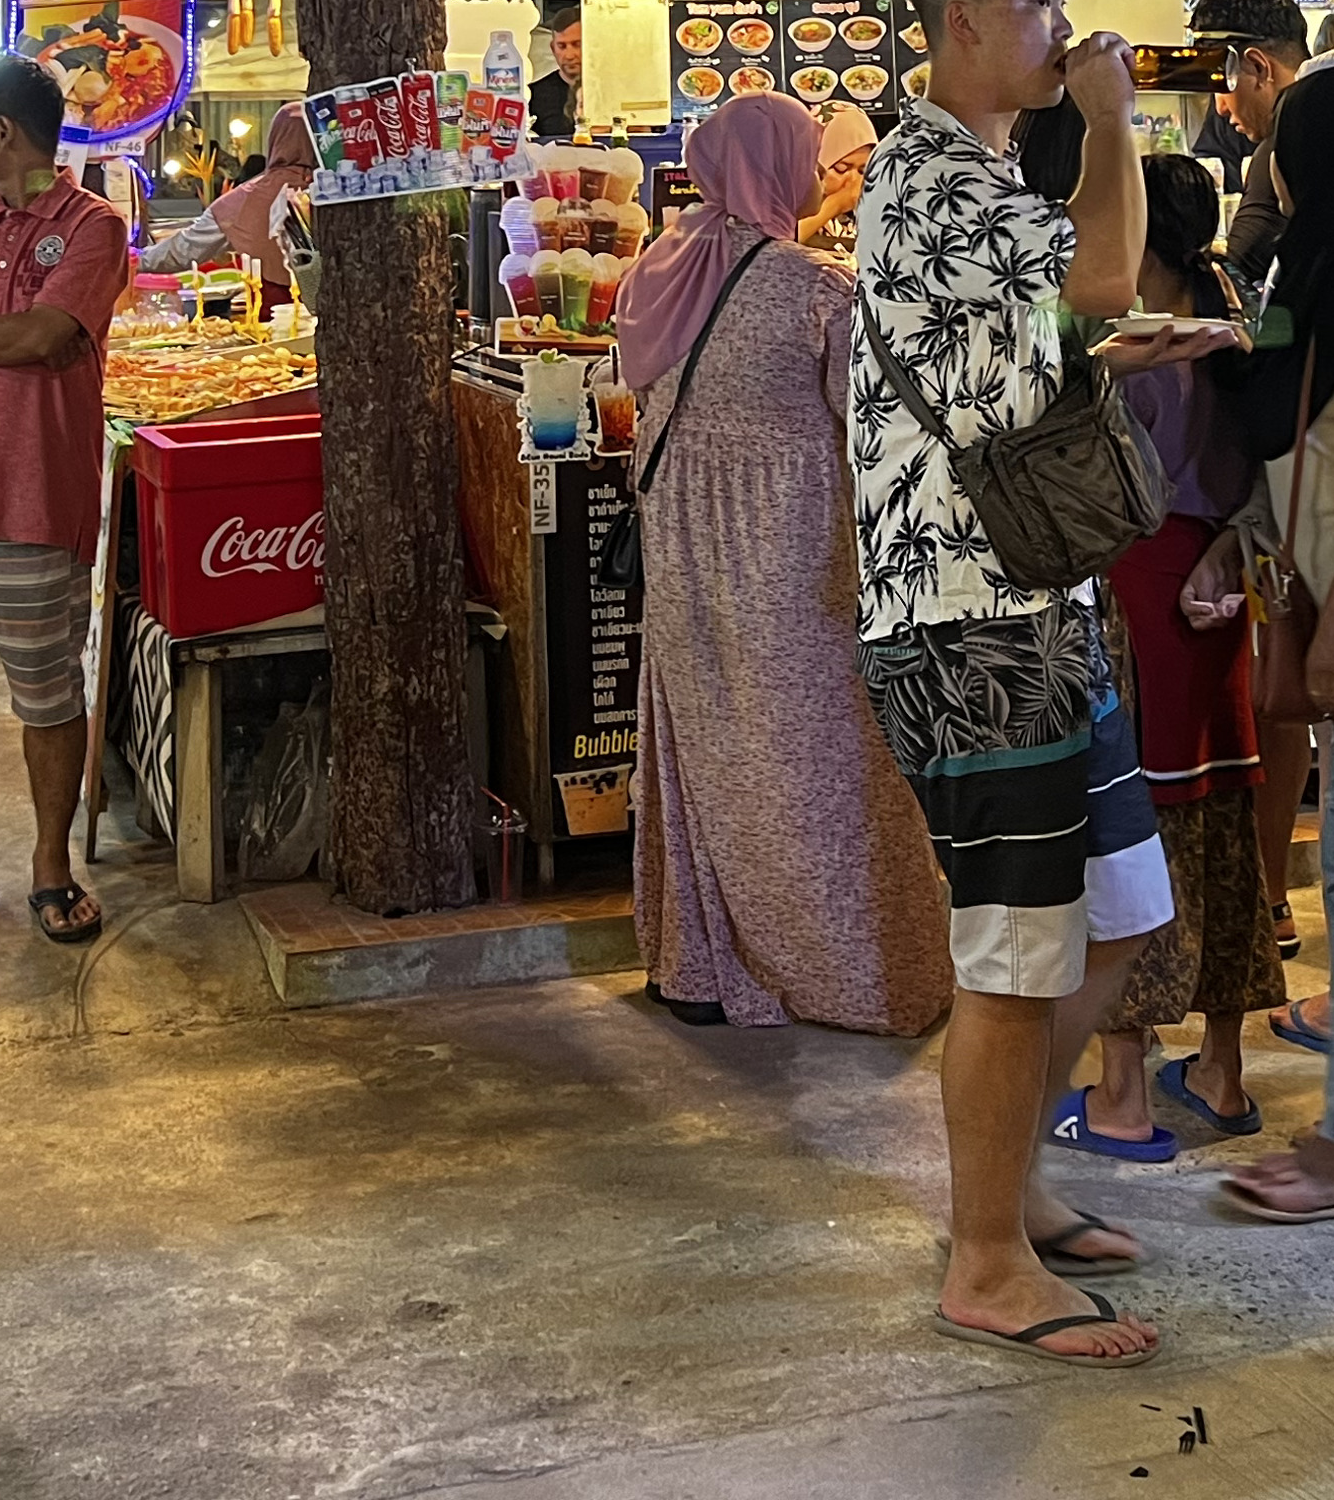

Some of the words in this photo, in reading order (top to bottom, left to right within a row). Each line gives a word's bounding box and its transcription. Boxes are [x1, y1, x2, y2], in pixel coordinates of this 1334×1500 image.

[104, 140, 142, 152] NF-46
[533, 464, 550, 527] NF-35
[574, 728, 640, 759] Bubble
